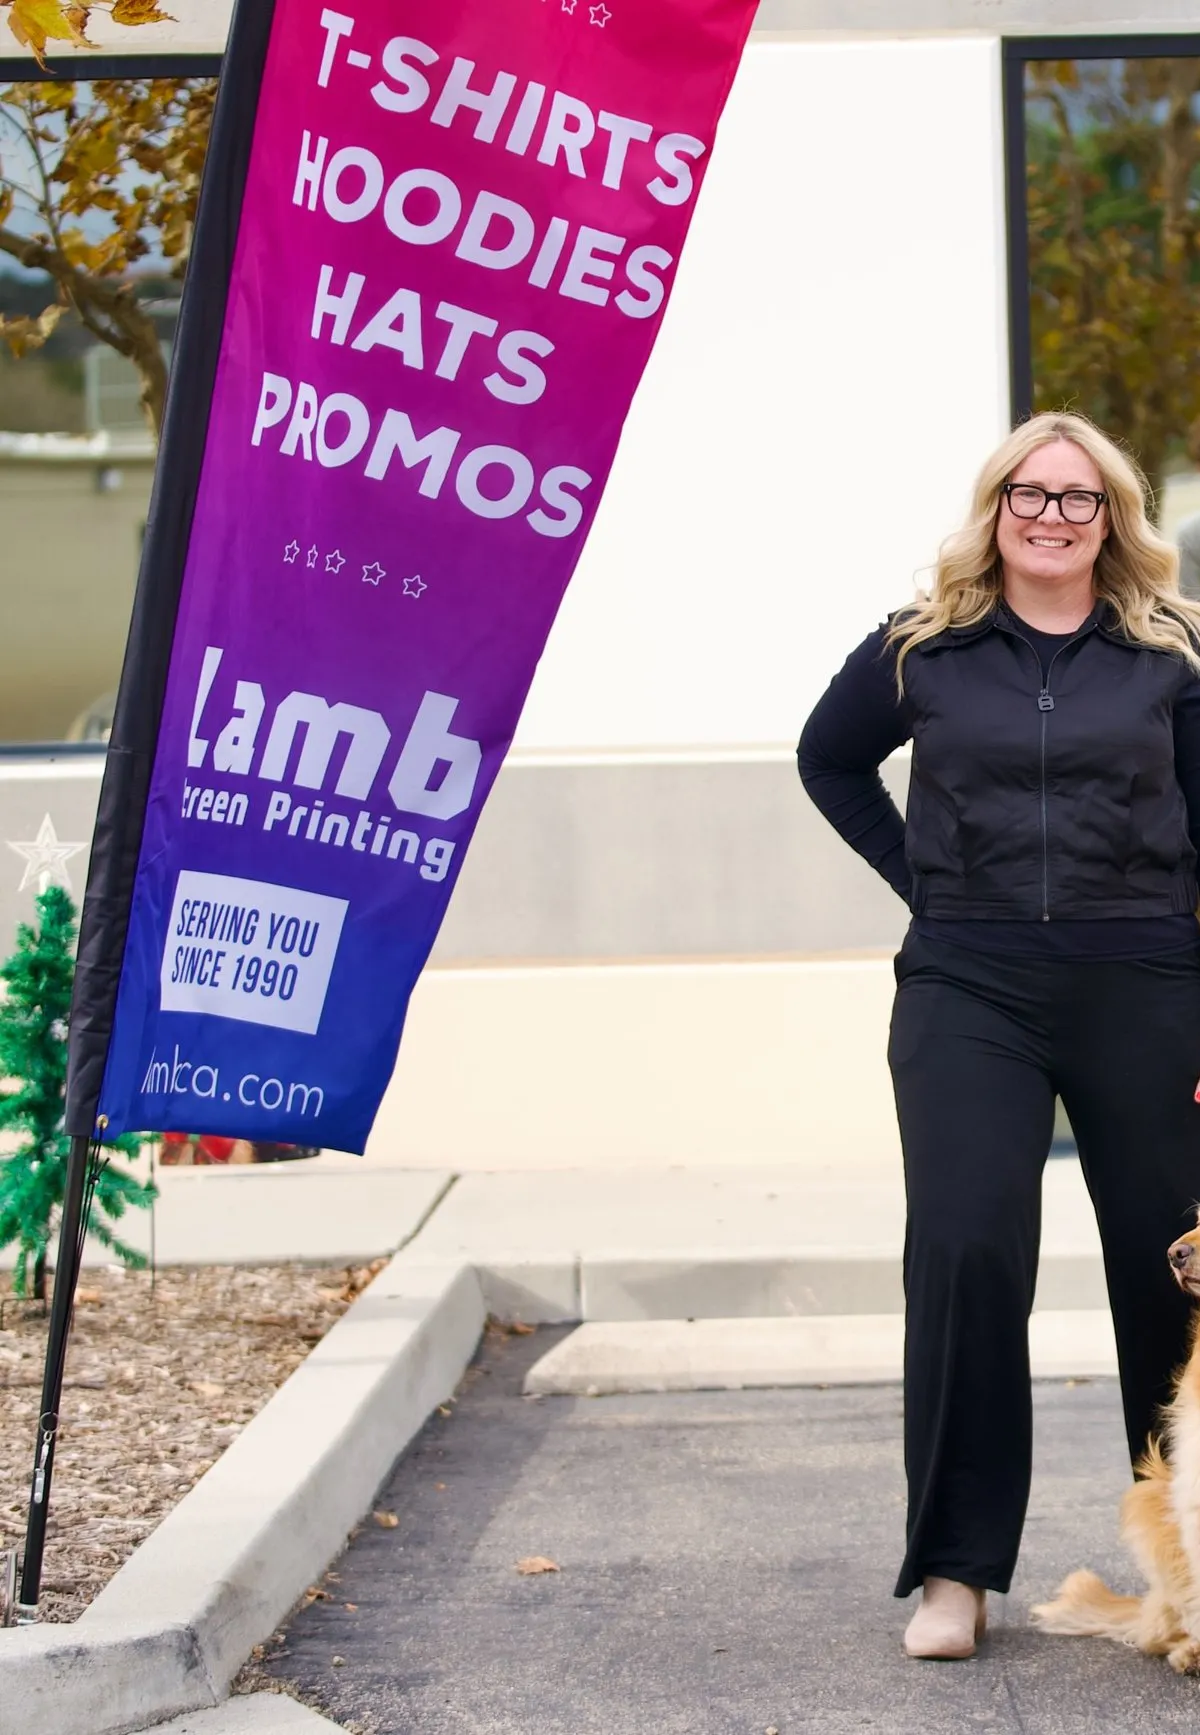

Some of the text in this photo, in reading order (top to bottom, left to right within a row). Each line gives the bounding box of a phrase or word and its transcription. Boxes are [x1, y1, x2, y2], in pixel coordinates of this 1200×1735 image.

[317, 8, 707, 207] T-SHIRTS
[292, 129, 675, 320] HOODIES
[310, 264, 556, 406] HATS
[251, 371, 593, 539] PROMOS
[187, 645, 483, 822] Lamb
[181, 777, 457, 883] creen Printing
[171, 945, 299, 1001] SINCE 1990
[176, 898, 320, 958] SERVING YOU
